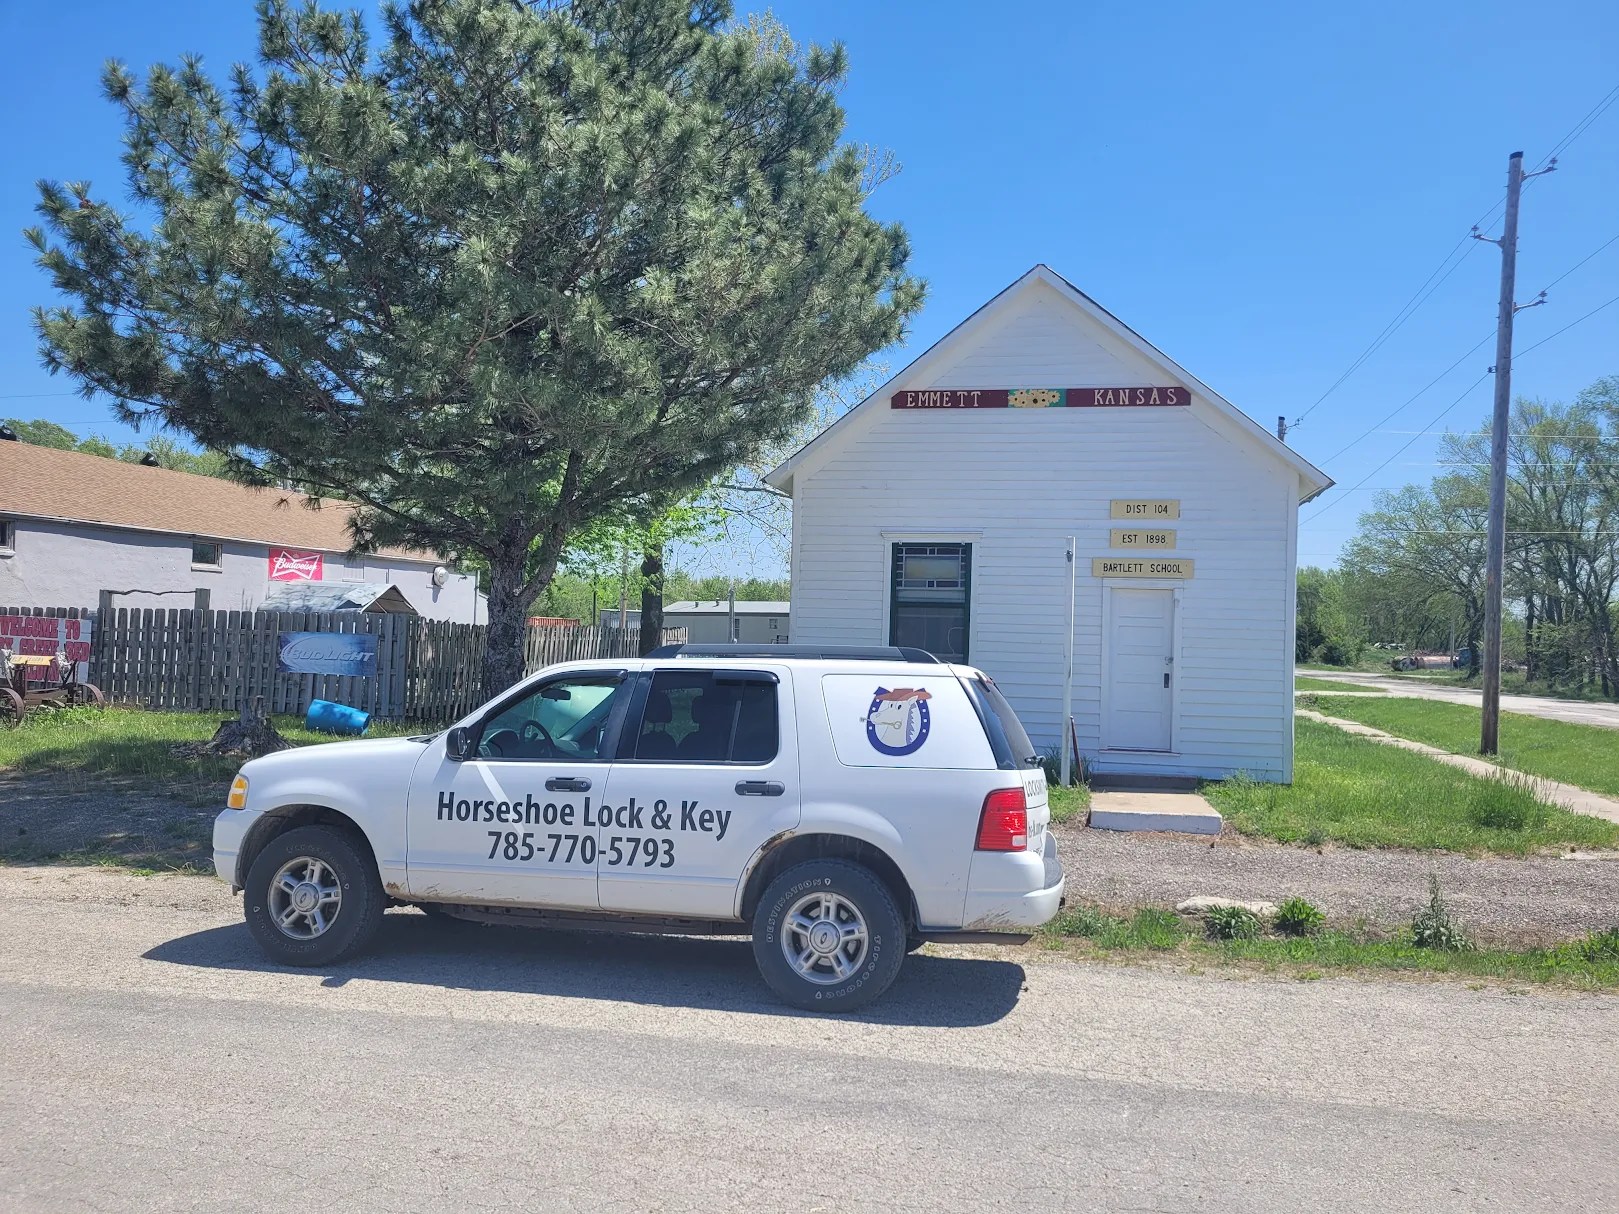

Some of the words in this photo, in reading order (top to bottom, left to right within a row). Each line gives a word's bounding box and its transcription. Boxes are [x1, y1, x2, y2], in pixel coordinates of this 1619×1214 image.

[906, 391, 981, 407] EMMETT
[1094, 388, 1177, 405] KANSAS
[1126, 504, 1147, 514] DIST
[1154, 504, 1168, 514] 104
[1122, 534, 1138, 544] EST
[1146, 534, 1166, 544] 1898
[273, 556, 317, 571] Budweiser
[1103, 562, 1144, 573] BARTLETT
[1150, 563, 1183, 574] SCHOOL
[0, 615, 59, 638] WELCOME
[65, 619, 80, 640] TO
[290, 649, 324, 660] BUD
[325, 648, 374, 662] LIGHT
[437, 791, 575, 826] Horseshoe
[583, 797, 643, 829] Lock
[651, 799, 671, 830] &
[680, 800, 732, 842] Key
[487, 831, 676, 868] 785-770-5793
[766, 877, 822, 943] DESTINATION
